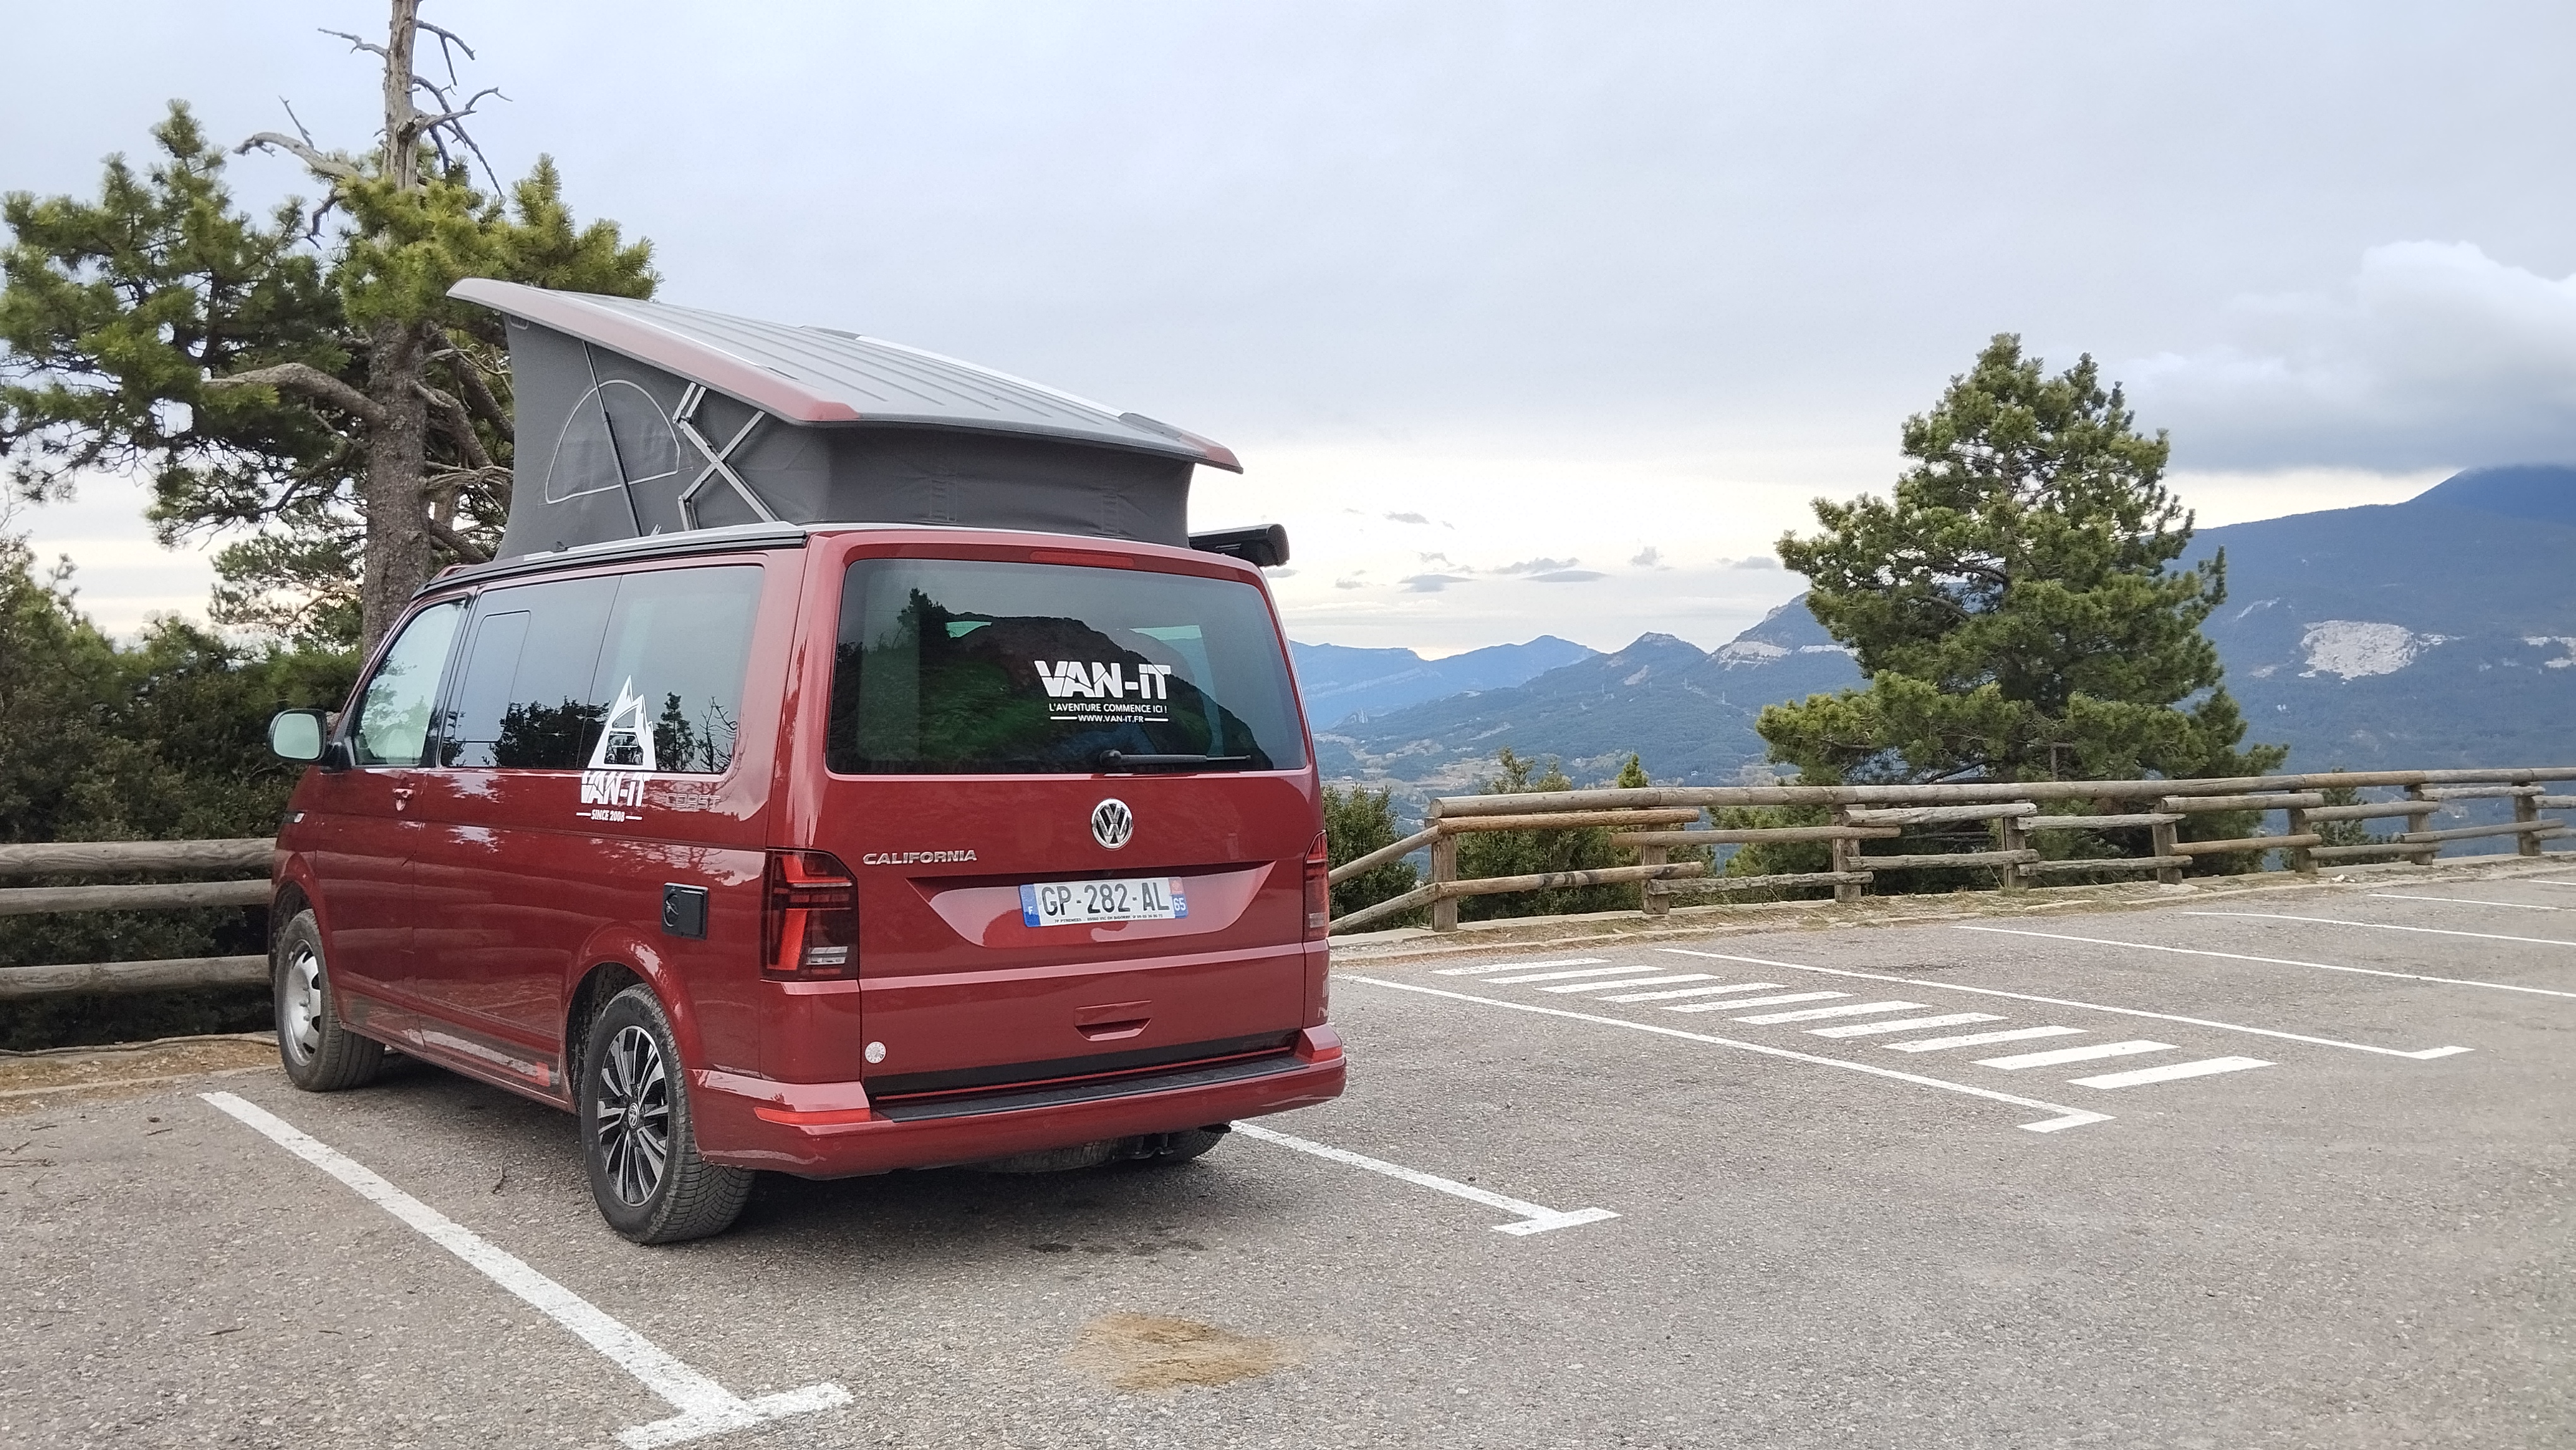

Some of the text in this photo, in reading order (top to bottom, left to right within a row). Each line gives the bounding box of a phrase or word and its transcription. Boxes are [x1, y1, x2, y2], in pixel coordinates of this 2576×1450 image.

[1049, 703, 1101, 712] L'AVENTURE
[1103, 704, 1152, 713] COMMENCE
[1153, 705, 1163, 713] ICI
[1077, 714, 1144, 722] WWW.VAN-IT.FR
[666, 793, 720, 810] COAST
[591, 809, 625, 822] SINCE 2008
[863, 849, 977, 865] CALIFORNIA
[1173, 897, 1186, 911] 65
[1029, 906, 1034, 916] F
